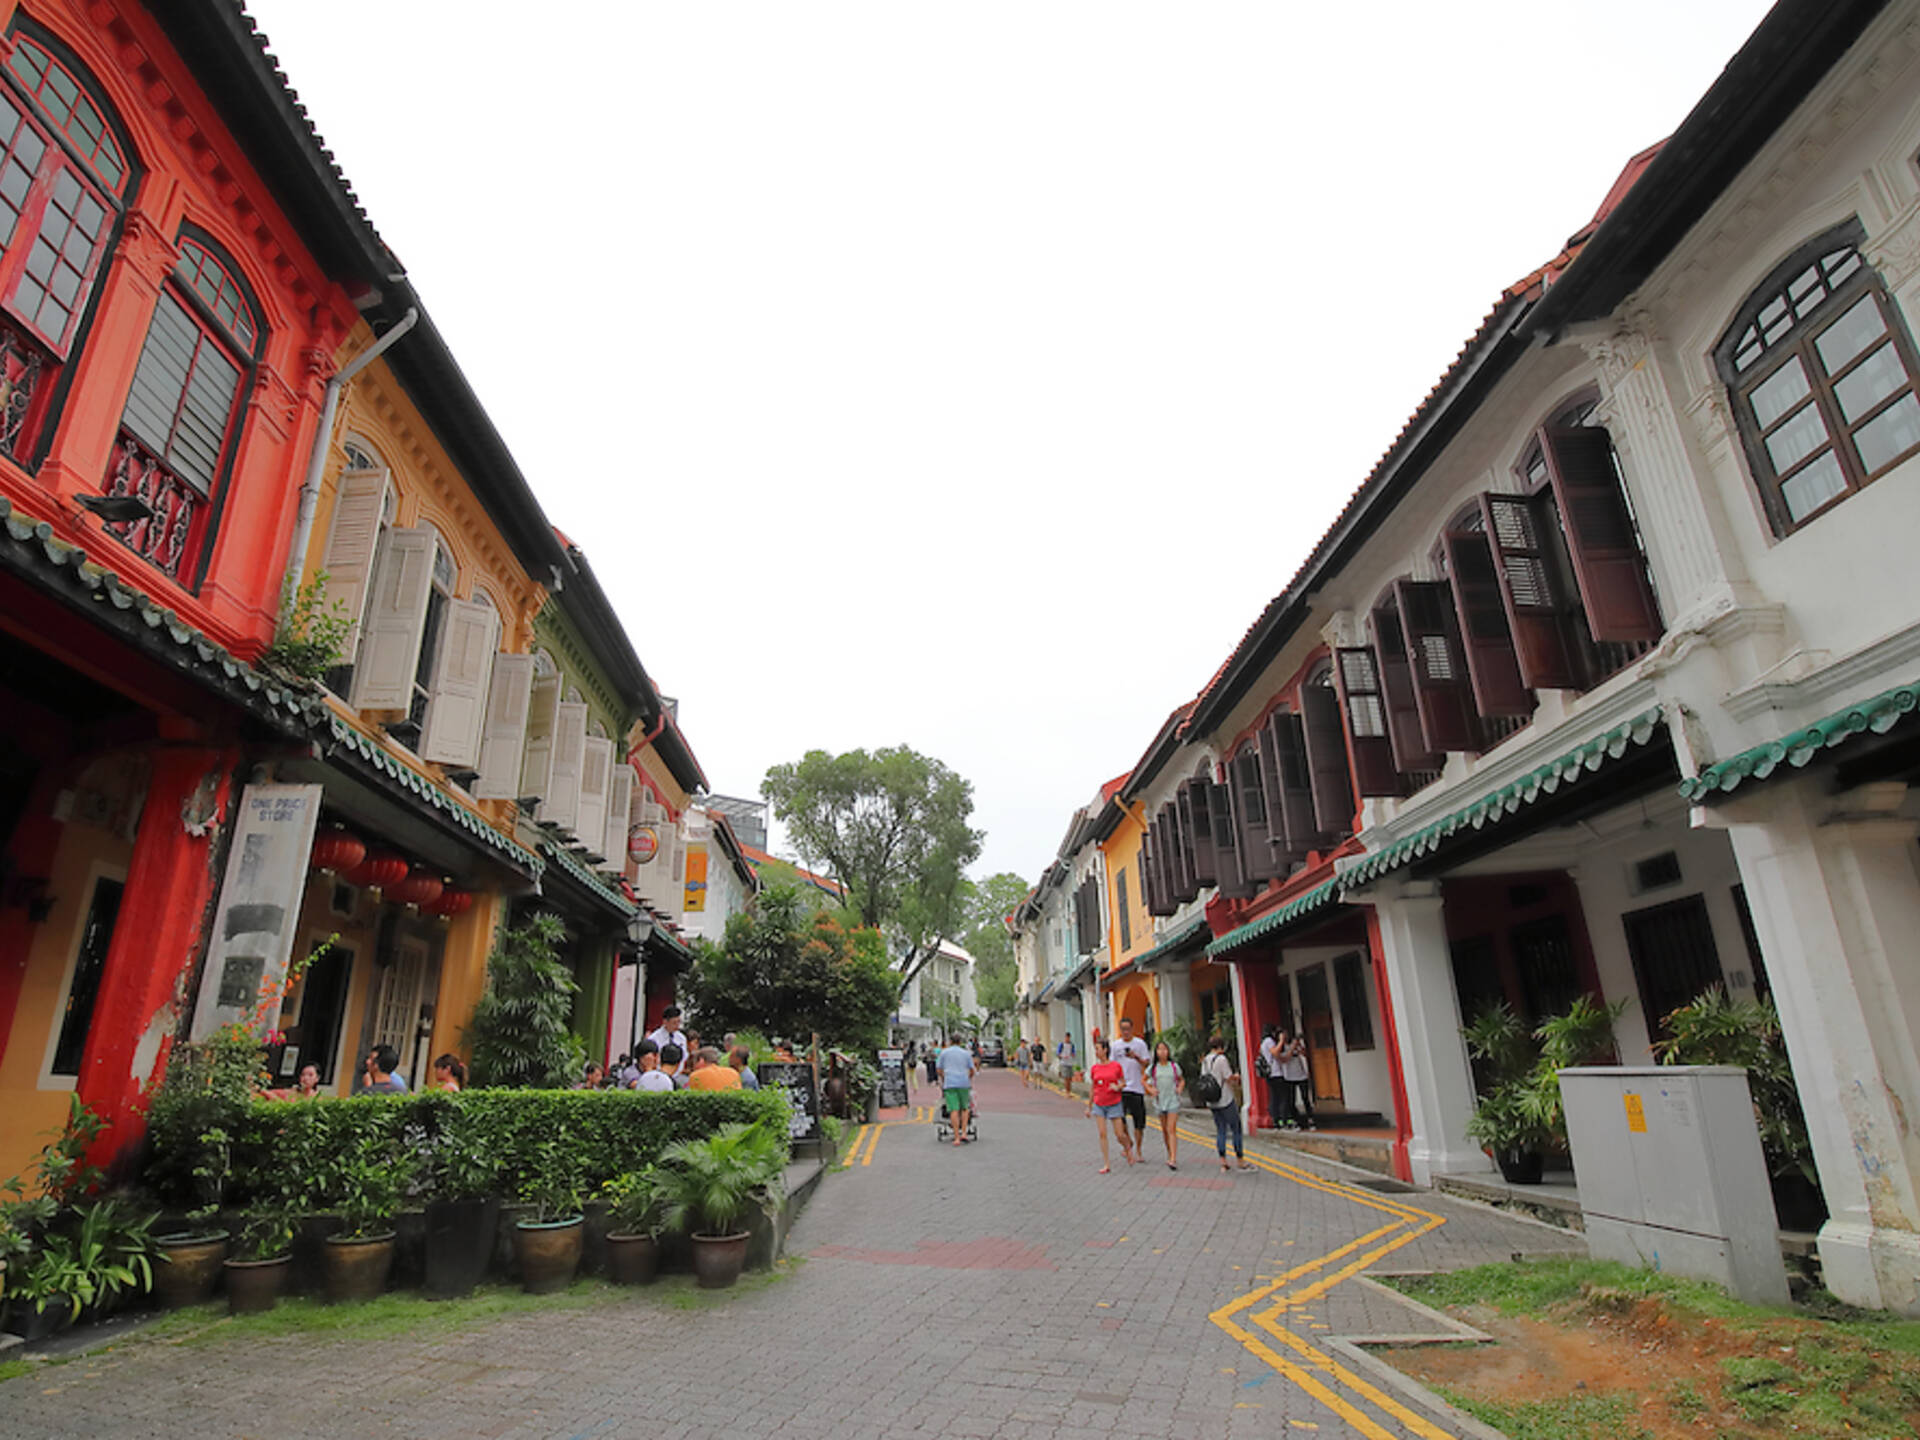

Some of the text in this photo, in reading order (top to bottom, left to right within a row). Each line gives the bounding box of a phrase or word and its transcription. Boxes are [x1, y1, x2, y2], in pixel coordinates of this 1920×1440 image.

[251, 798, 306, 809] ONE PRICE
[258, 809, 294, 821] STORE
